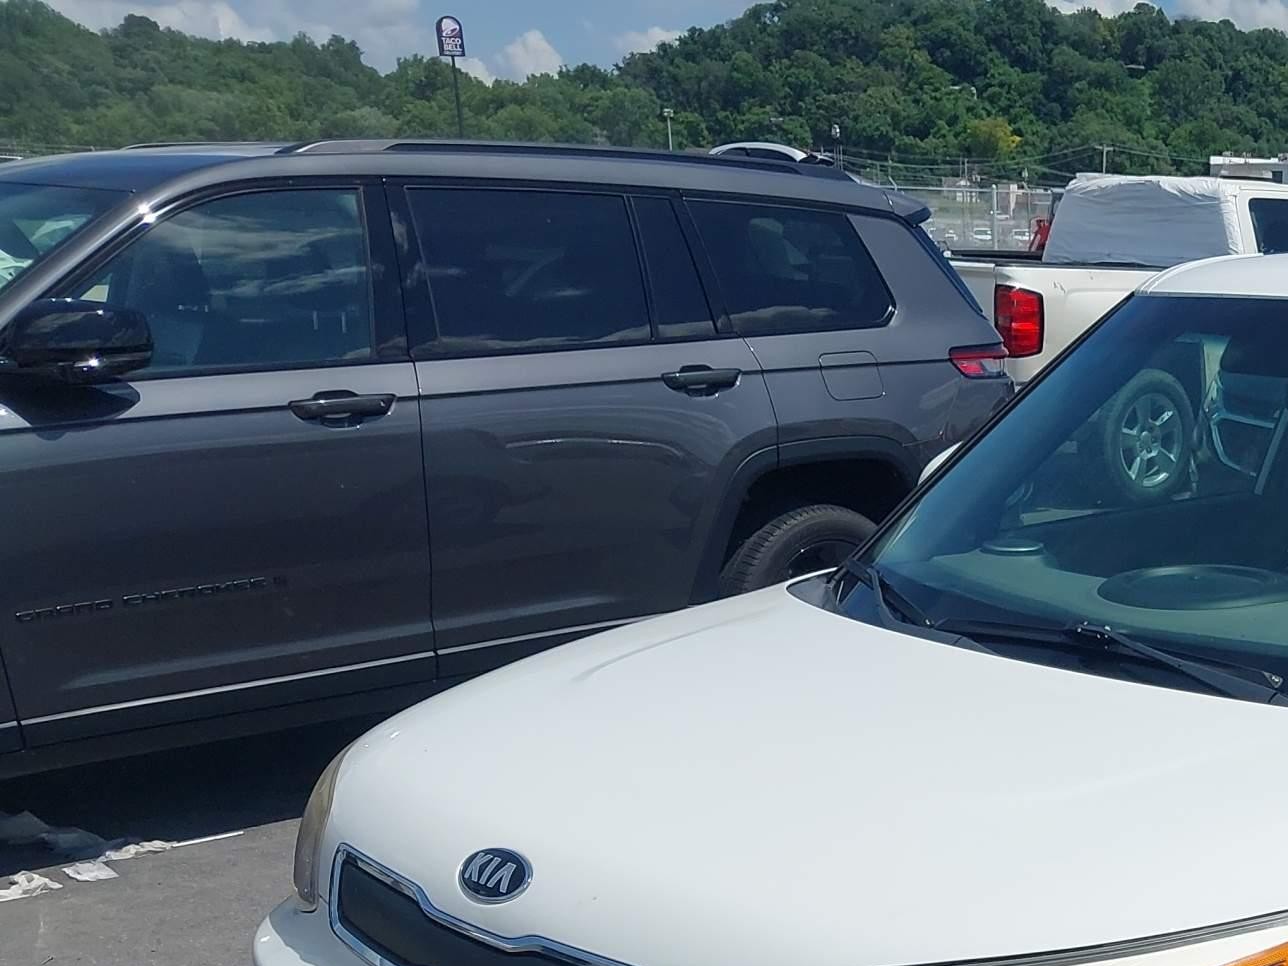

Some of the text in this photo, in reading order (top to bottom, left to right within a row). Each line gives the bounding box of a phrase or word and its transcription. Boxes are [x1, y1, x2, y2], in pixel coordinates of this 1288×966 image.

[16, 577, 266, 622] GRAND CHEROKEE
[464, 852, 516, 893] KIA
